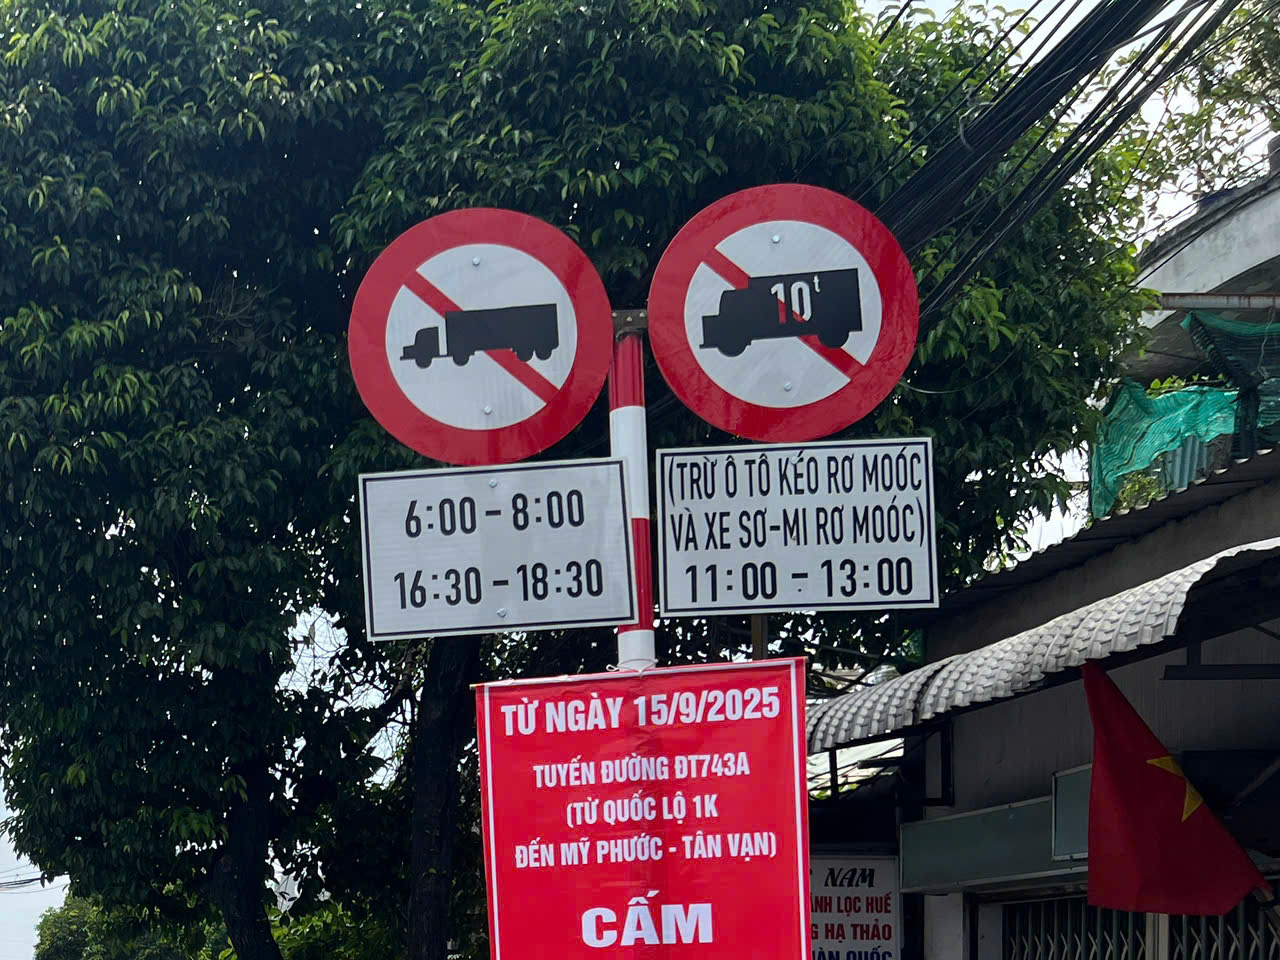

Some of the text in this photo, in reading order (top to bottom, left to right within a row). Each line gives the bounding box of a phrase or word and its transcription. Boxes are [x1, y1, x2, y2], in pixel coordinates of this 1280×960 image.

[669, 447, 921, 504] (TRỪ Ô TÔ KÉO RƠ MOÓC
[406, 490, 584, 537] 6:00 8:00
[670, 495, 924, 551] VÀ XE SƠ-MI RƠ MOÓC)
[394, 559, 603, 609] 16:30 18:30
[686, 557, 912, 602] 11:00 13:00
[501, 687, 779, 735] TỪ NGÀY 15/9/2025
[533, 752, 749, 787] TUYẾN ĐƯỜNG ĐT743A
[567, 791, 717, 827] (TỪ QUỐC LỘ 1K
[516, 831, 776, 867] ĐẾN MỸ PHƯỚC TÂN VẠN)
[824, 867, 875, 888] NAM
[582, 891, 712, 947] CẤM
[837, 896, 861, 917] LỌC
[866, 891, 892, 914] HUẾ
[825, 923, 845, 943] HẠ
[851, 919, 892, 941] THẢO
